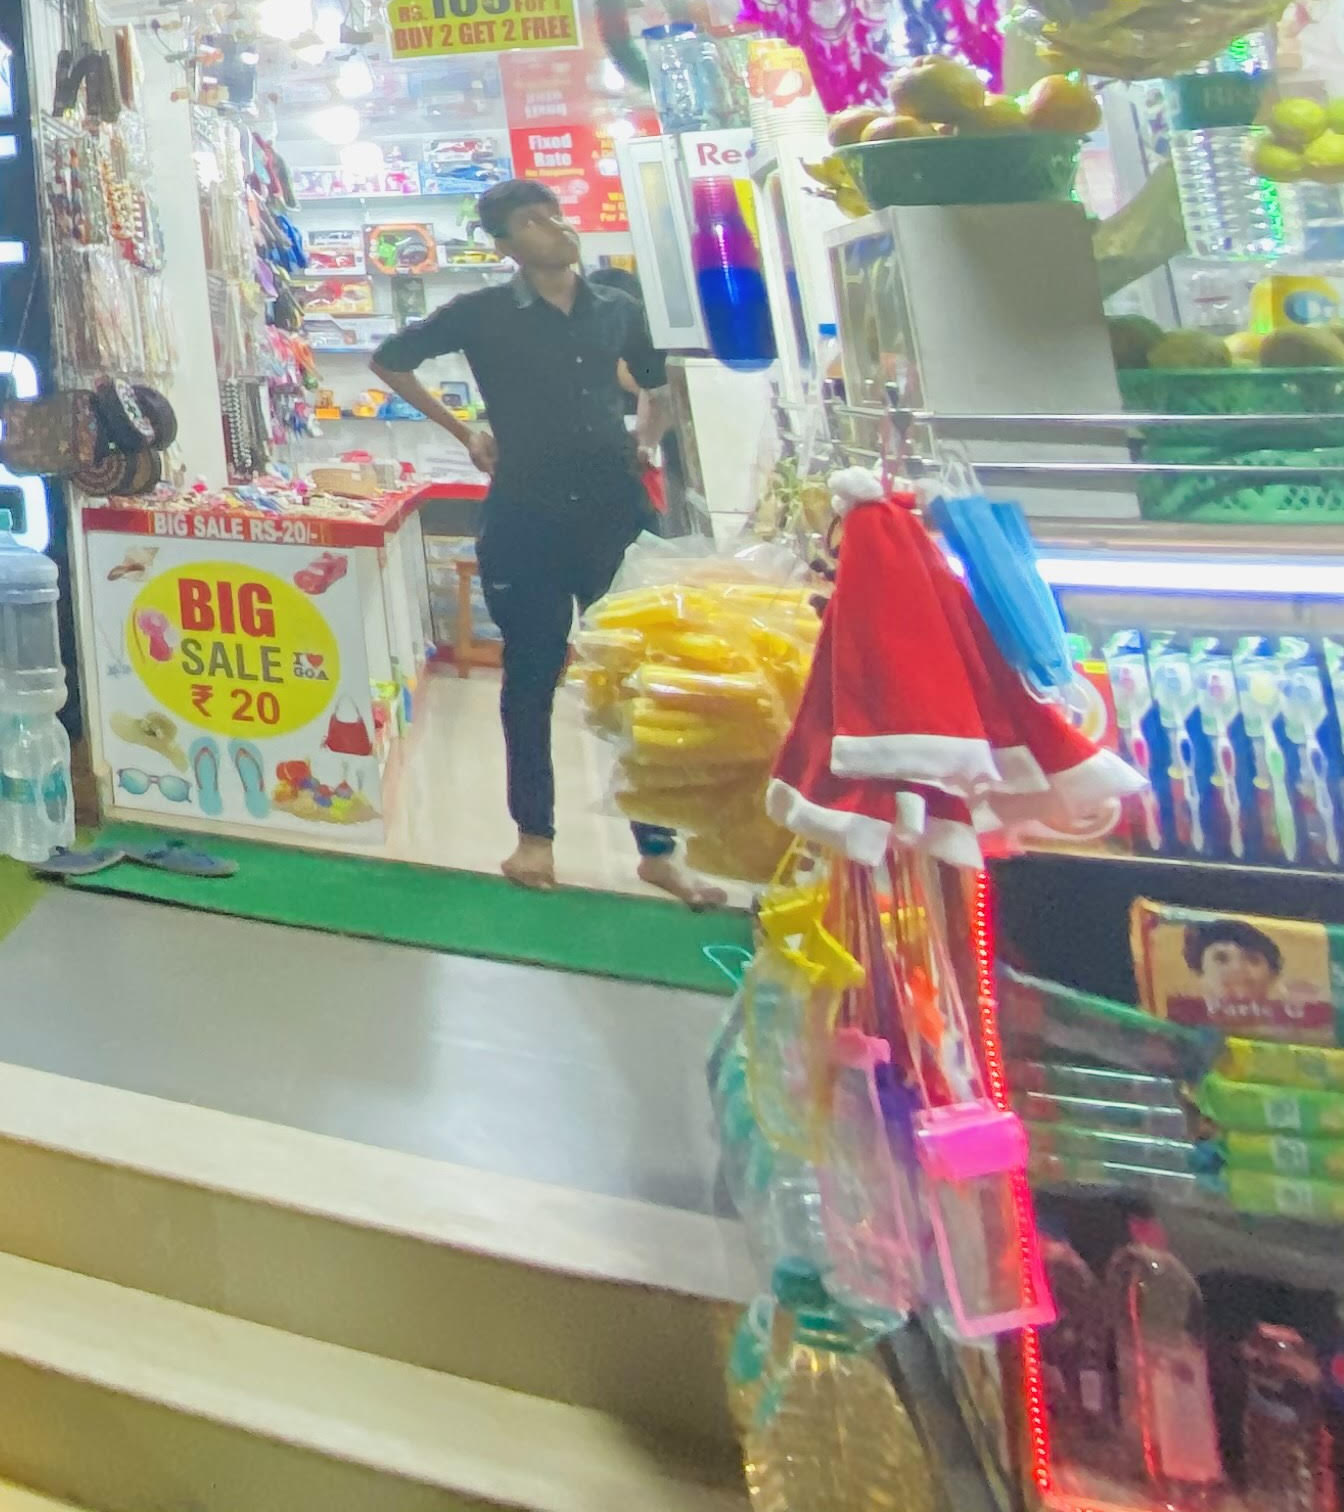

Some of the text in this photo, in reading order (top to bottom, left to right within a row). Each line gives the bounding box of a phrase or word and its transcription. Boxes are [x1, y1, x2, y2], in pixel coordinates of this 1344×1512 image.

[394, 15, 571, 52] BUY 2 GET 2 FREE
[154, 509, 188, 537] BIG
[194, 516, 244, 540] SALE
[178, 578, 276, 638] BIG
[181, 638, 284, 684] SALE
[293, 666, 330, 681] GOA
[230, 689, 281, 725] 20
